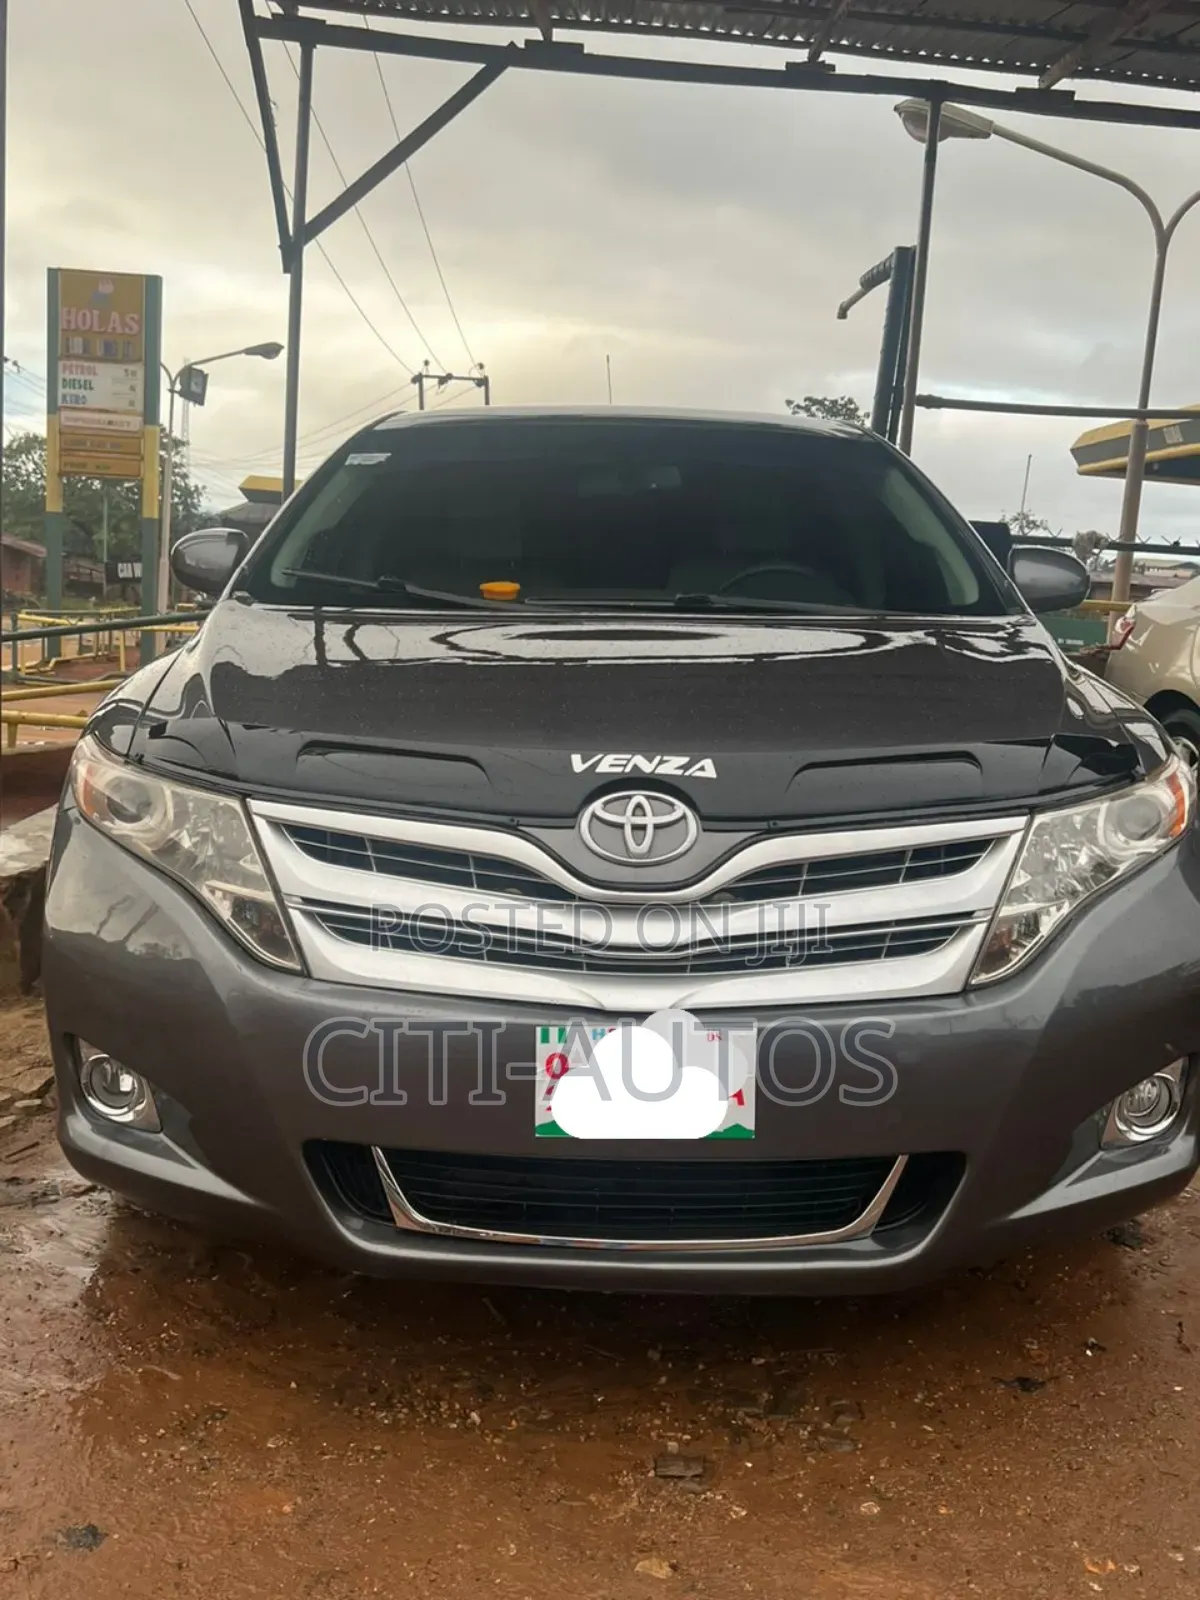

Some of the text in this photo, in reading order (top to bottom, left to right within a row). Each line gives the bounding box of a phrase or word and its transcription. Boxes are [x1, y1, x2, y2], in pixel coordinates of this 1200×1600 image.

[61, 307, 140, 335] HOLAS
[62, 362, 99, 377] PETROL
[61, 378, 95, 391] DIESEL
[571, 753, 718, 779] VENZA
